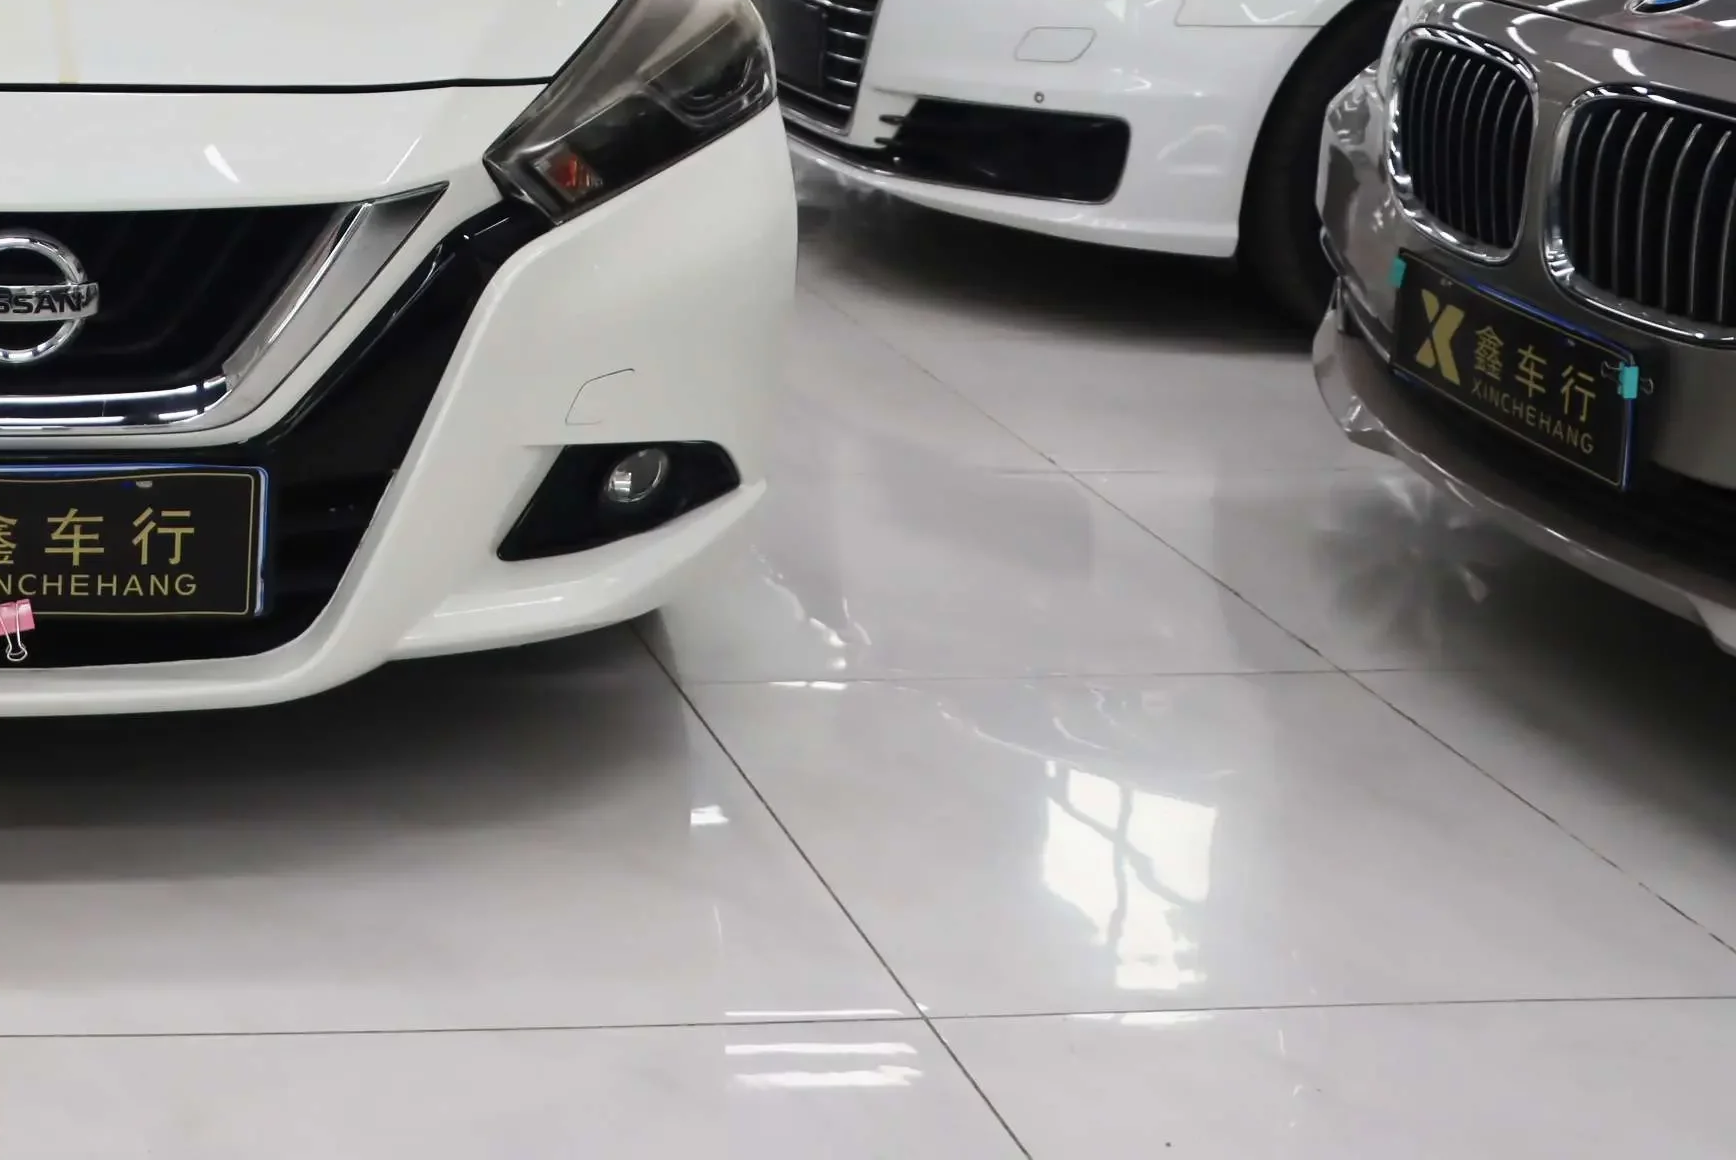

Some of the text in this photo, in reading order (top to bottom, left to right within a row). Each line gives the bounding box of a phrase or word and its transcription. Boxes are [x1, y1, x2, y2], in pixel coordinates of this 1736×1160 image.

[1472, 377, 1595, 455] XINCHEHANG
[1473, 325, 1597, 422] 鑫车行
